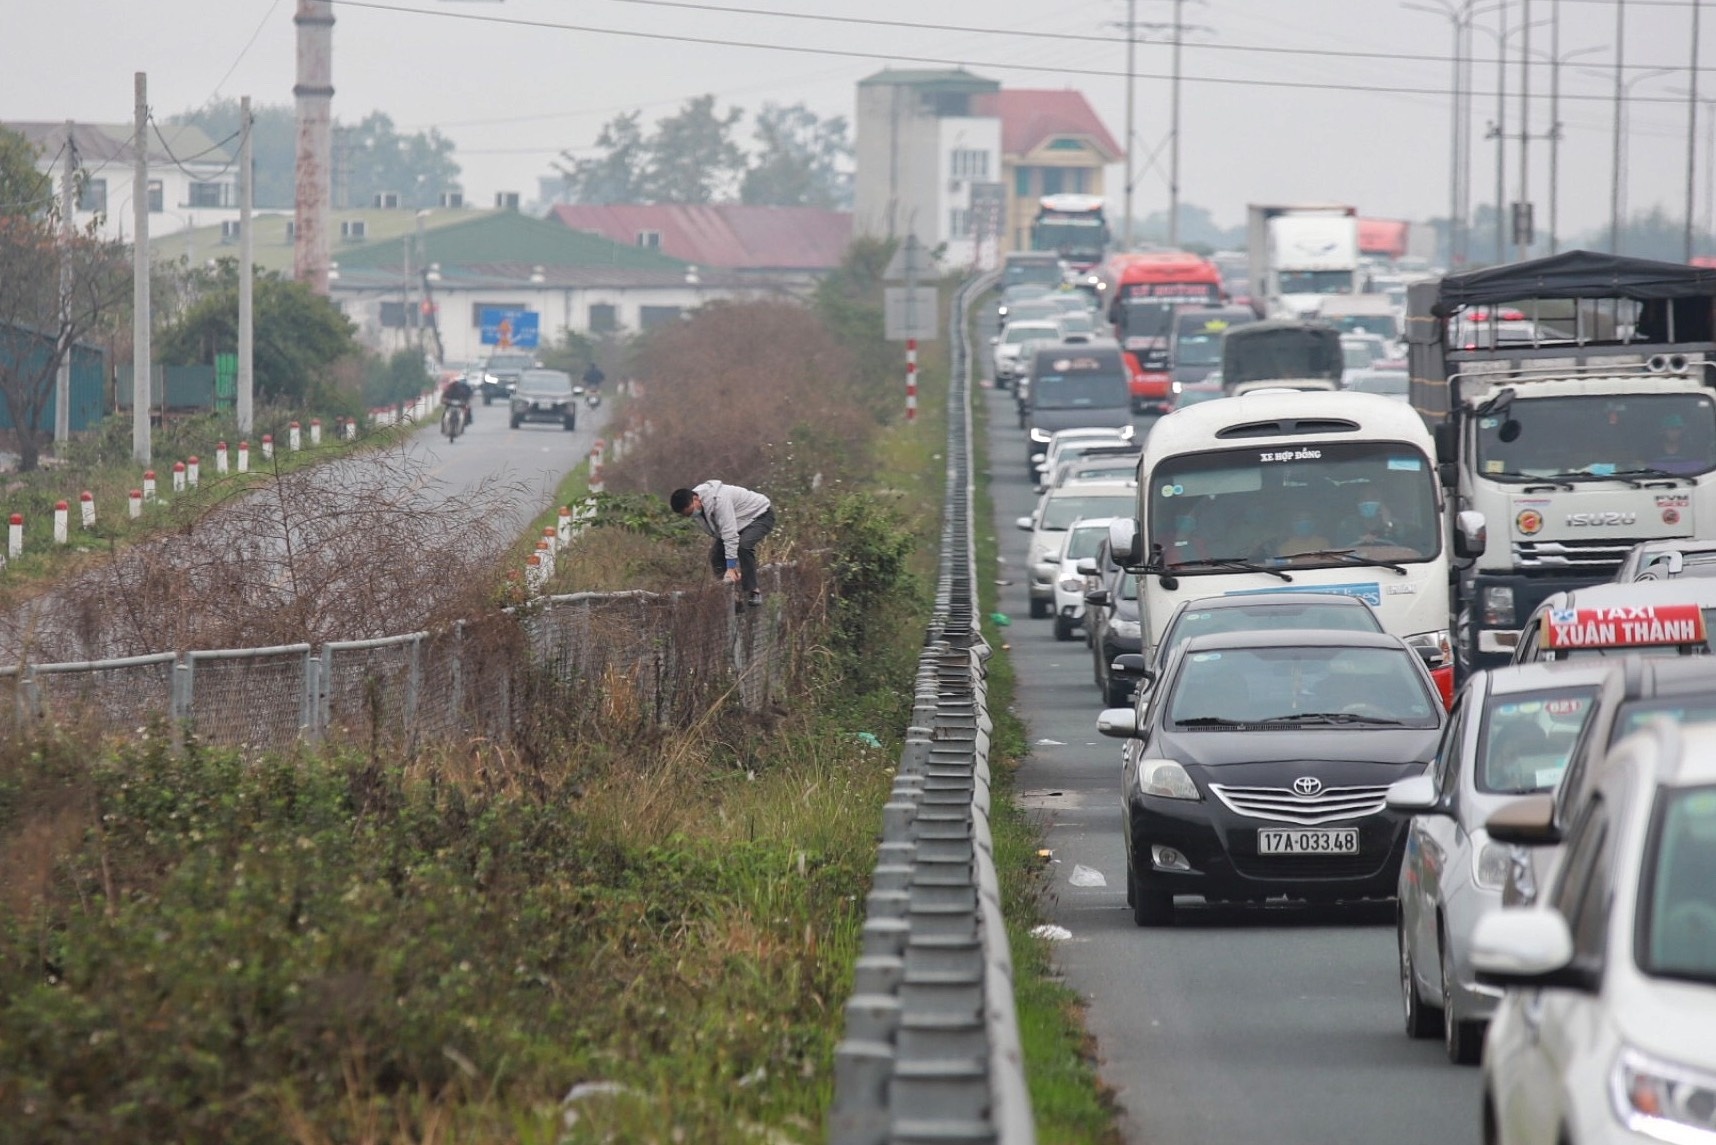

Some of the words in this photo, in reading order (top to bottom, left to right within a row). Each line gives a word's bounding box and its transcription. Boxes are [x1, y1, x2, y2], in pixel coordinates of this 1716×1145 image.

[1260, 453, 1275, 462] XE
[1275, 451, 1294, 462] HỢP
[1566, 512, 1636, 527] ISUZU
[1596, 606, 1655, 620] TAXI
[1555, 619, 1616, 645] XUÂN
[1622, 617, 1696, 643] THÀNH
[1264, 833, 1355, 851] 17A-033.48
